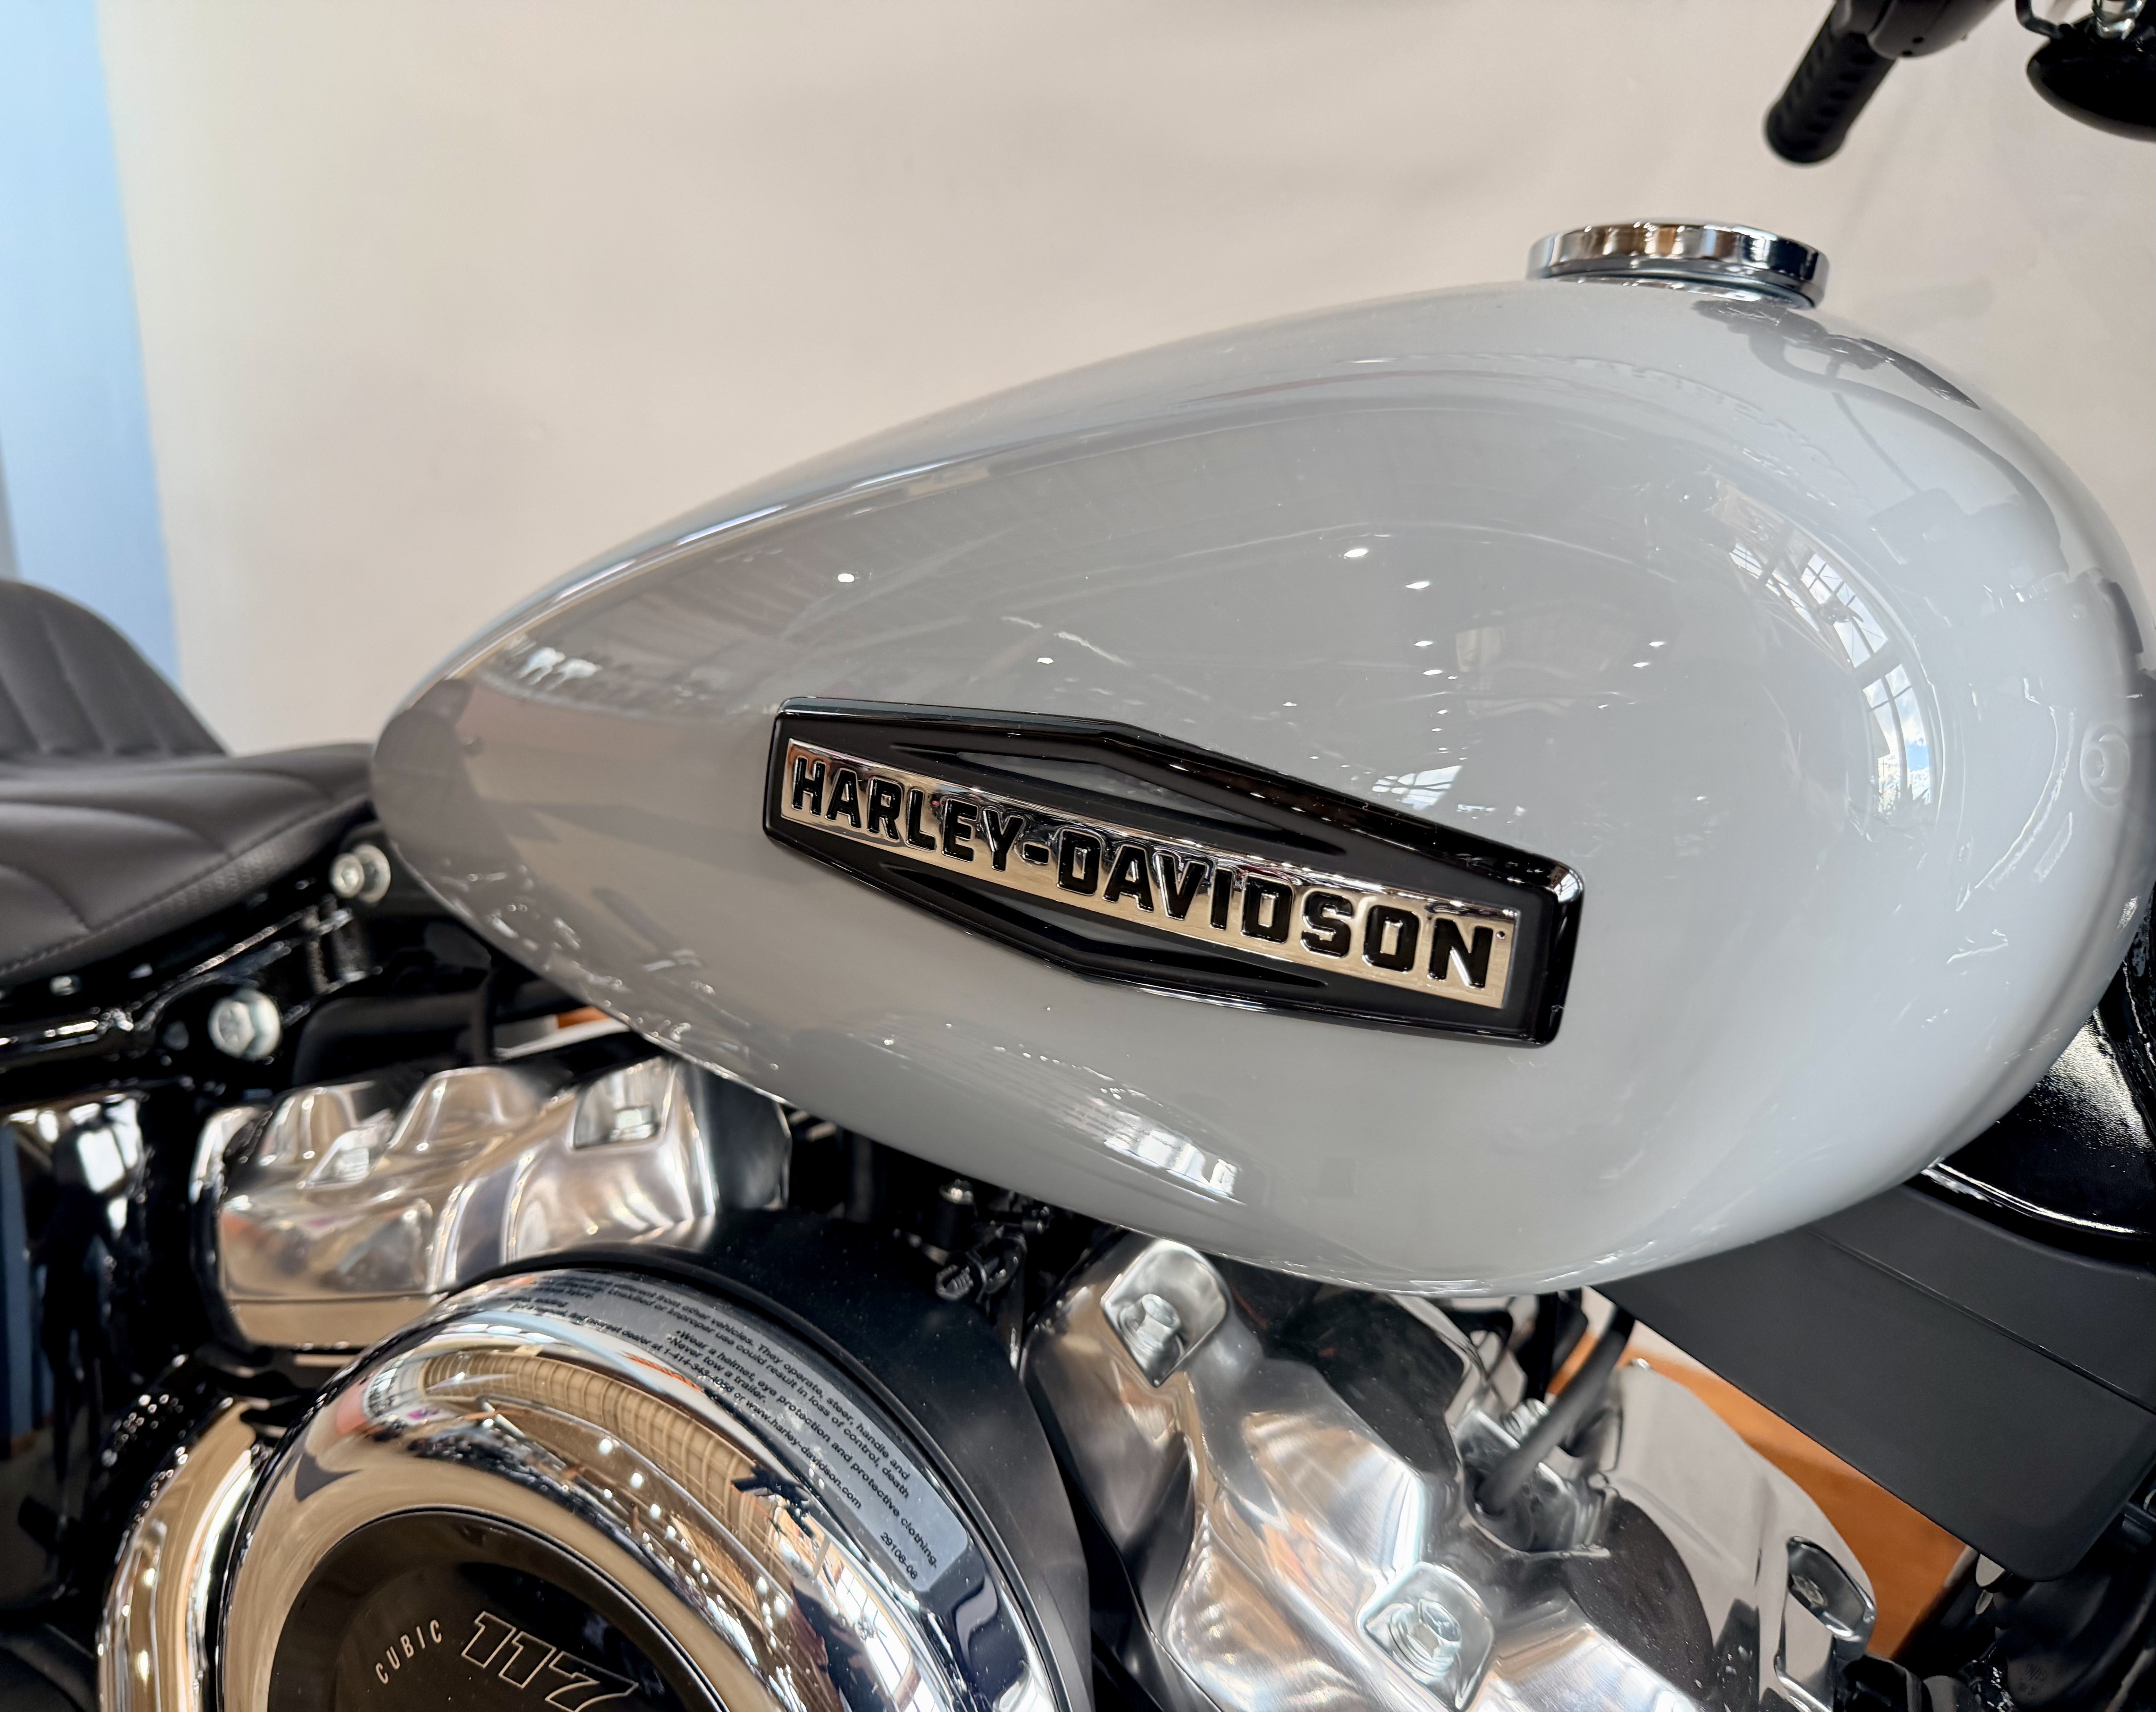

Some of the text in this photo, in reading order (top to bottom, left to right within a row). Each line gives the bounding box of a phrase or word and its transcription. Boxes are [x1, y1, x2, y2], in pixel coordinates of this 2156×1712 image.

[792, 756, 1494, 990] HARLEY-DAVIDSON
[652, 1342, 663, 1352] at
[734, 1392, 745, 1401] or
[746, 1400, 862, 1509] www.harley-davidson.com
[667, 1309, 715, 1333] improper
[715, 1332, 734, 1345] use
[736, 1344, 767, 1365] could
[766, 1364, 797, 1388] result
[797, 1386, 807, 1397] in
[809, 1395, 831, 1417] loss
[832, 1416, 845, 1428] of
[844, 1428, 880, 1467] control,
[882, 1467, 909, 1499] death
[671, 1337, 703, 1358] Never
[703, 1356, 725, 1371] tow
[734, 1375, 766, 1403] trailer.
[680, 1331, 708, 1349] Wear
[717, 1352, 755, 1382] helmet,
[758, 1380, 777, 1397] eye
[777, 1395, 831, 1442] protection
[831, 1442, 853, 1463] and
[851, 1462, 900, 1517] protective
[901, 1517, 937, 1568] clothing.
[683, 1305, 710, 1319] other
[711, 1318, 753, 1346] vehicles.
[759, 1344, 783, 1364] They
[784, 1363, 823, 1398] operate,
[827, 1398, 854, 1424] steer,
[856, 1422, 889, 1458] handle
[890, 1459, 910, 1480] and
[375, 1619, 442, 1684] CUBIC
[462, 1610, 639, 1712] 117
